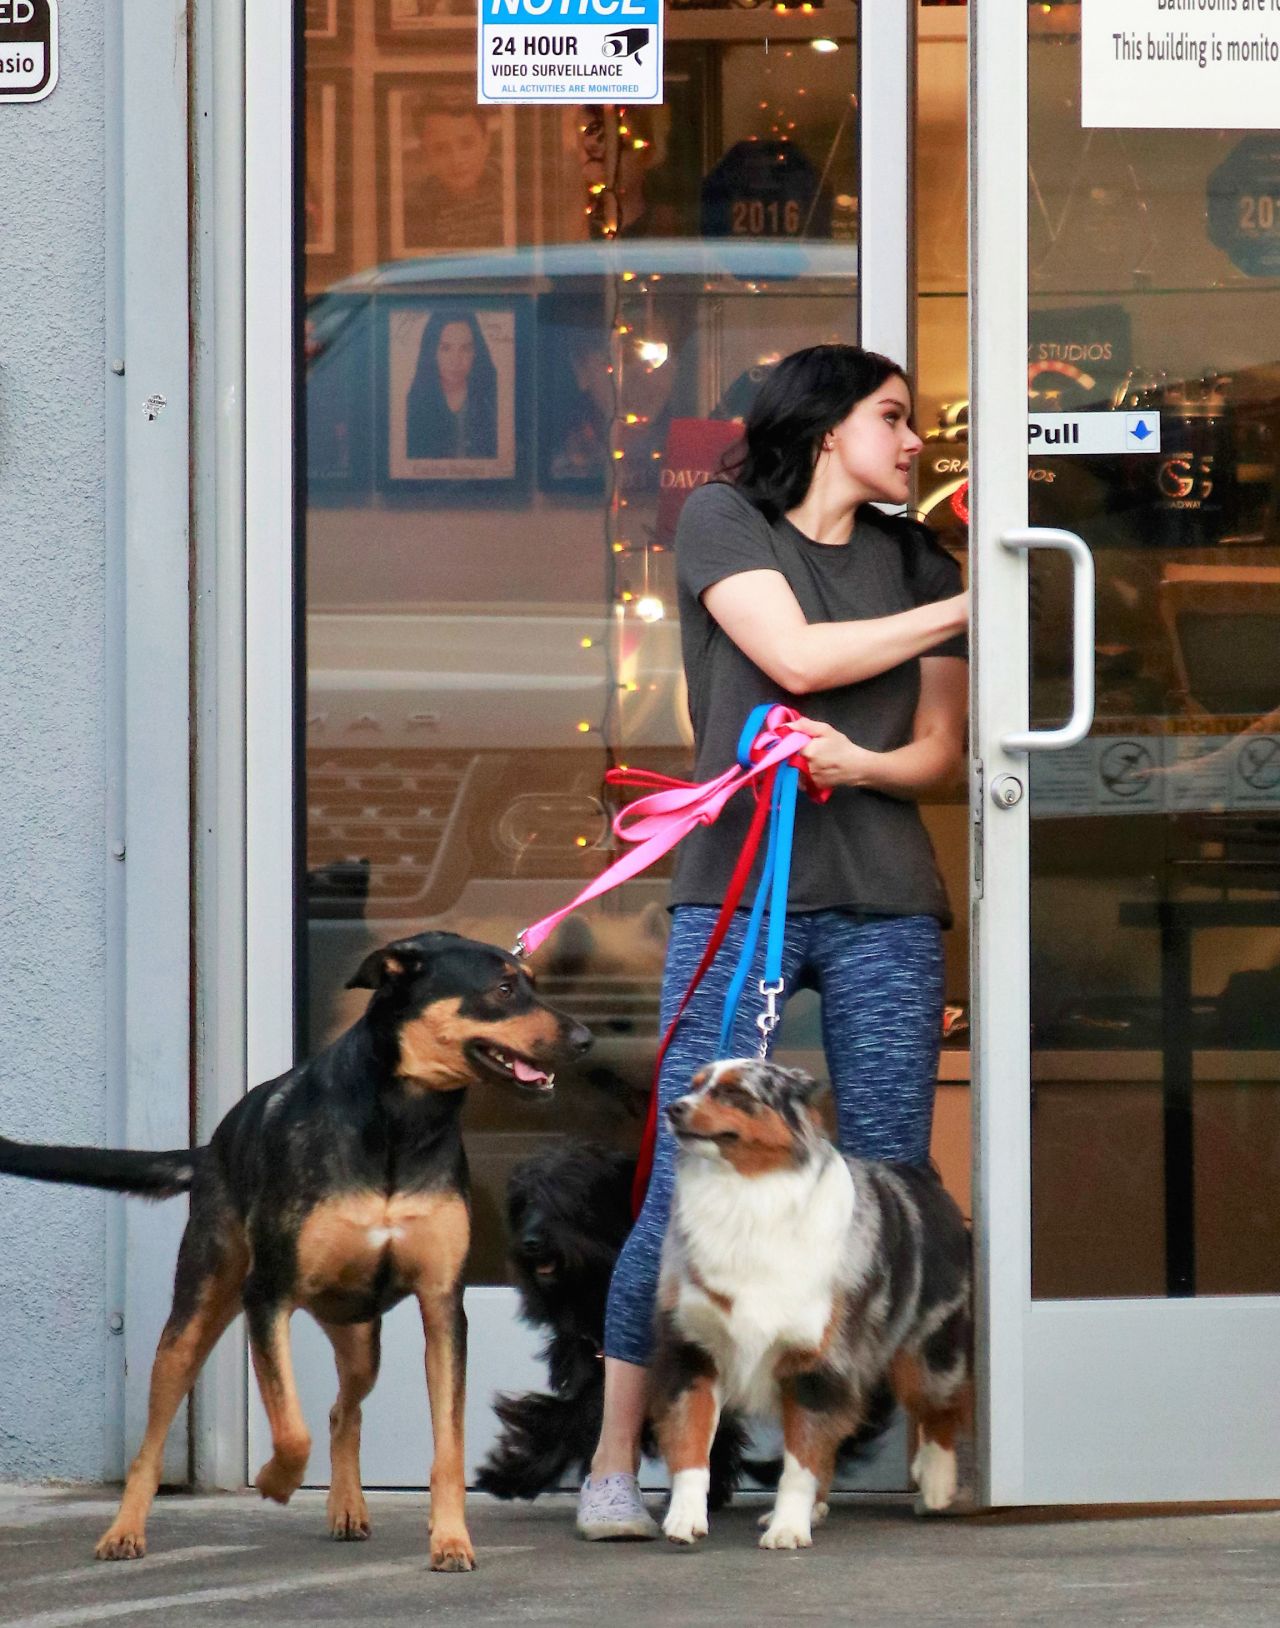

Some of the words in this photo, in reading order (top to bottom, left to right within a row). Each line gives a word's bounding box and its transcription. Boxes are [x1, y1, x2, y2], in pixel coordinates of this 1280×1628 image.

[492, 37, 515, 56] 24
[524, 36, 578, 56] HOUR
[1112, 32, 1142, 61] This
[1147, 32, 1207, 69] building
[1211, 33, 1223, 62] is
[492, 64, 528, 76] VIDEO
[532, 64, 623, 77] SURVEILLANCE
[520, 85, 566, 93] ACTIVITIES
[588, 85, 639, 93] MONITORED
[732, 200, 800, 233] 2016
[1239, 195, 1280, 229] 20
[1039, 343, 1113, 361] STUDIOS
[1028, 423, 1079, 444] Pull
